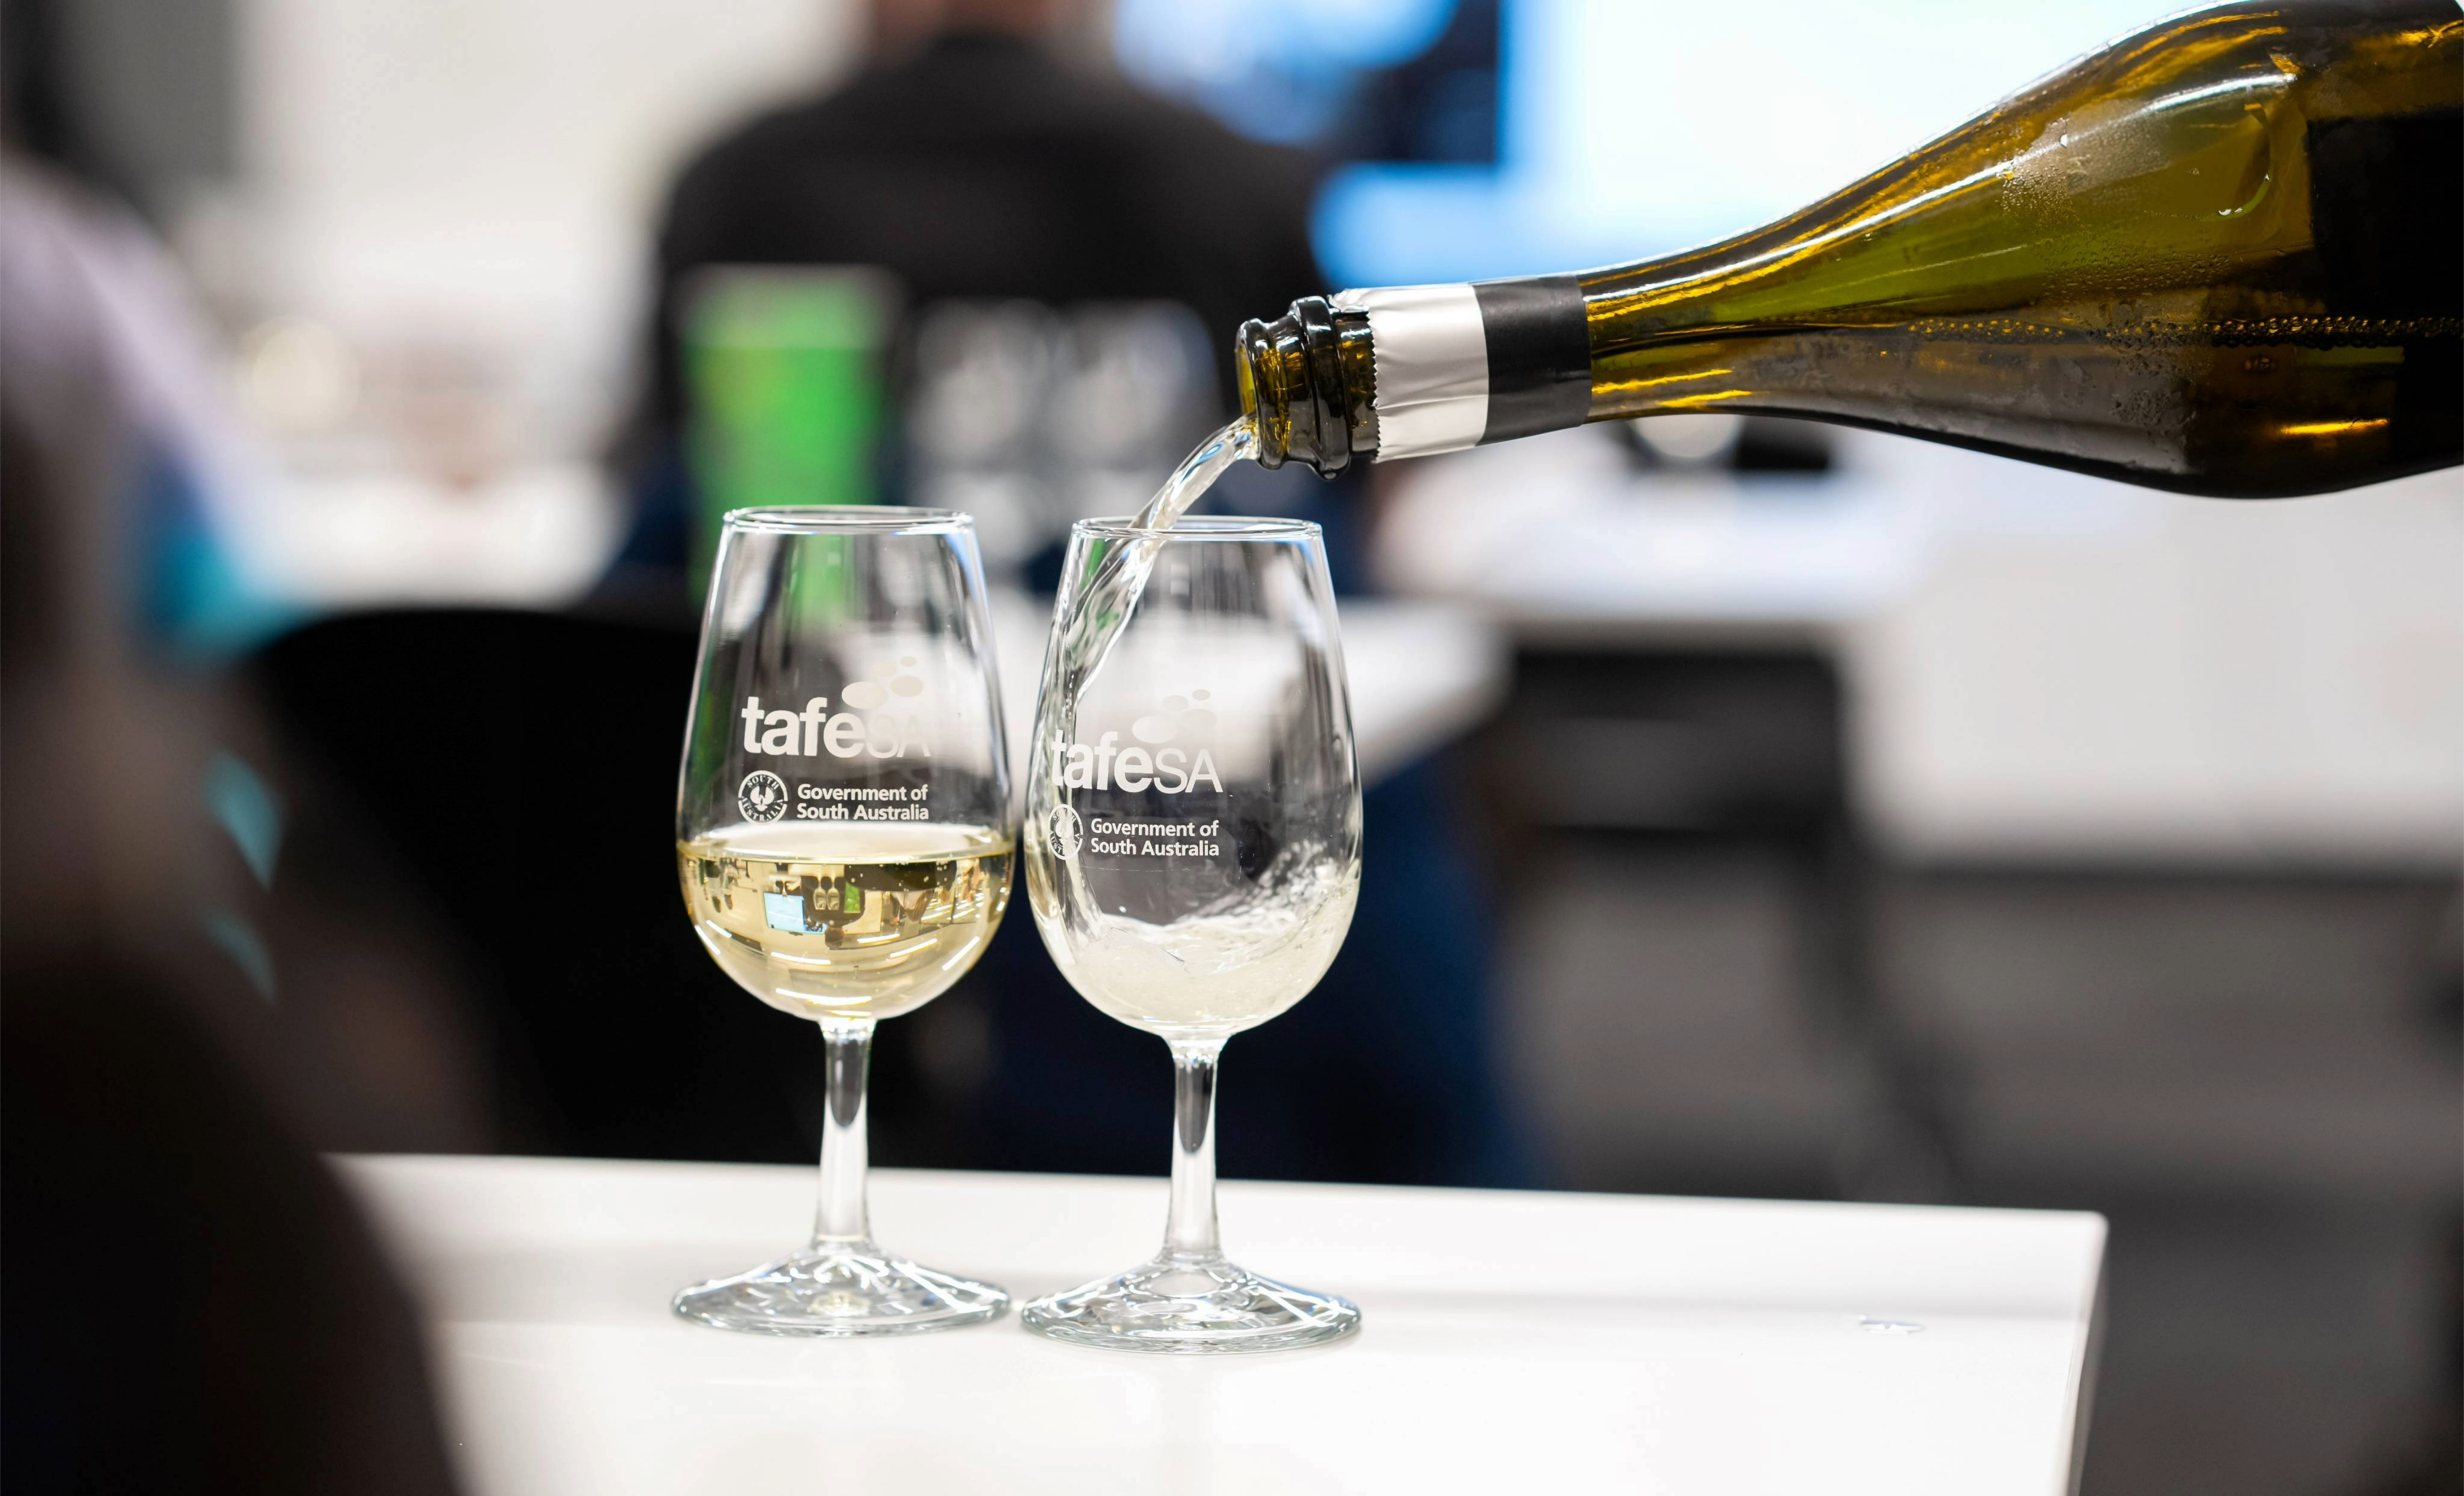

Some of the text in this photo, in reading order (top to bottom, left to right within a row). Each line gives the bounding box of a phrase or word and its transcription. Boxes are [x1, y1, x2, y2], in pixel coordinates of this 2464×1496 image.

[1051, 729, 1223, 794] tafeSA
[798, 784, 928, 801] Government of
[797, 803, 929, 820] South Australia
[1091, 818, 1219, 836] Government of
[1091, 837, 1219, 857] South Australia
